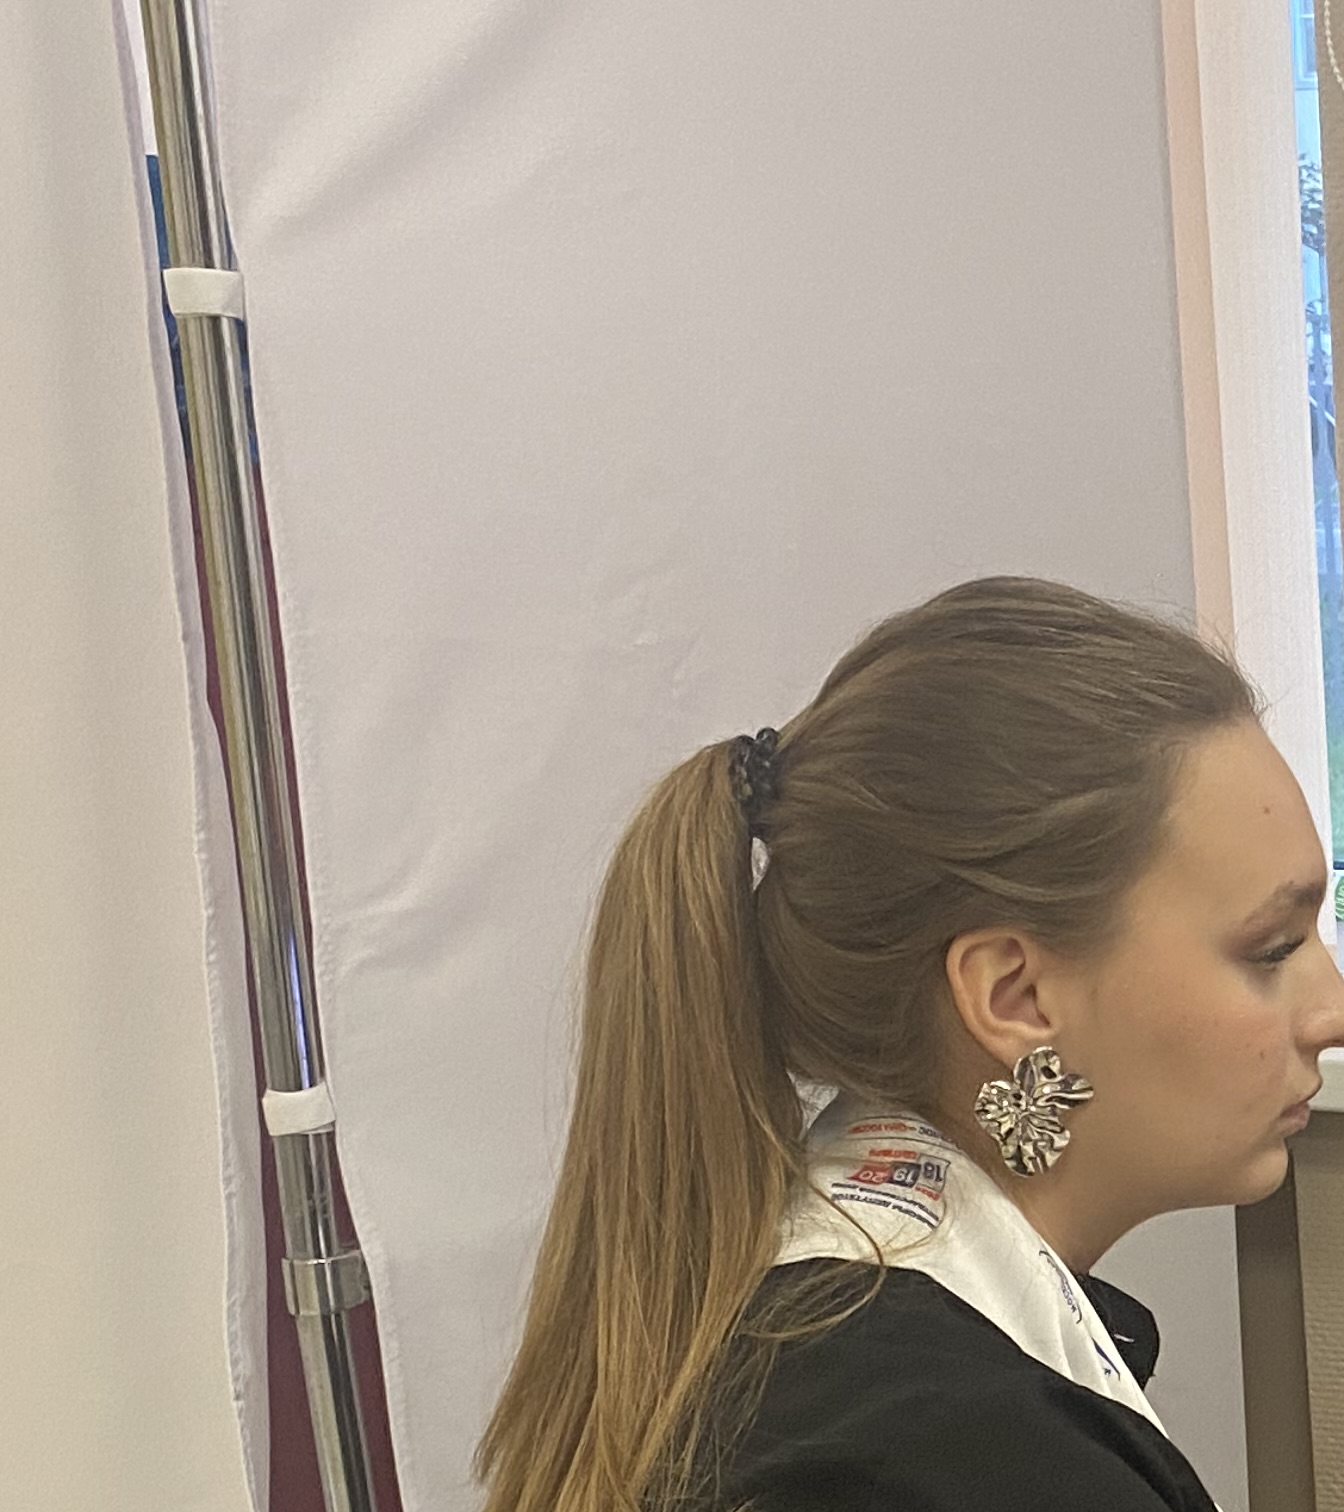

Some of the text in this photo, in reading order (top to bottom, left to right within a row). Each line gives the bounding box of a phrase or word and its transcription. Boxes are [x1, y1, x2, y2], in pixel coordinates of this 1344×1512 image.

[858, 1162, 942, 1184] 18 19 20
